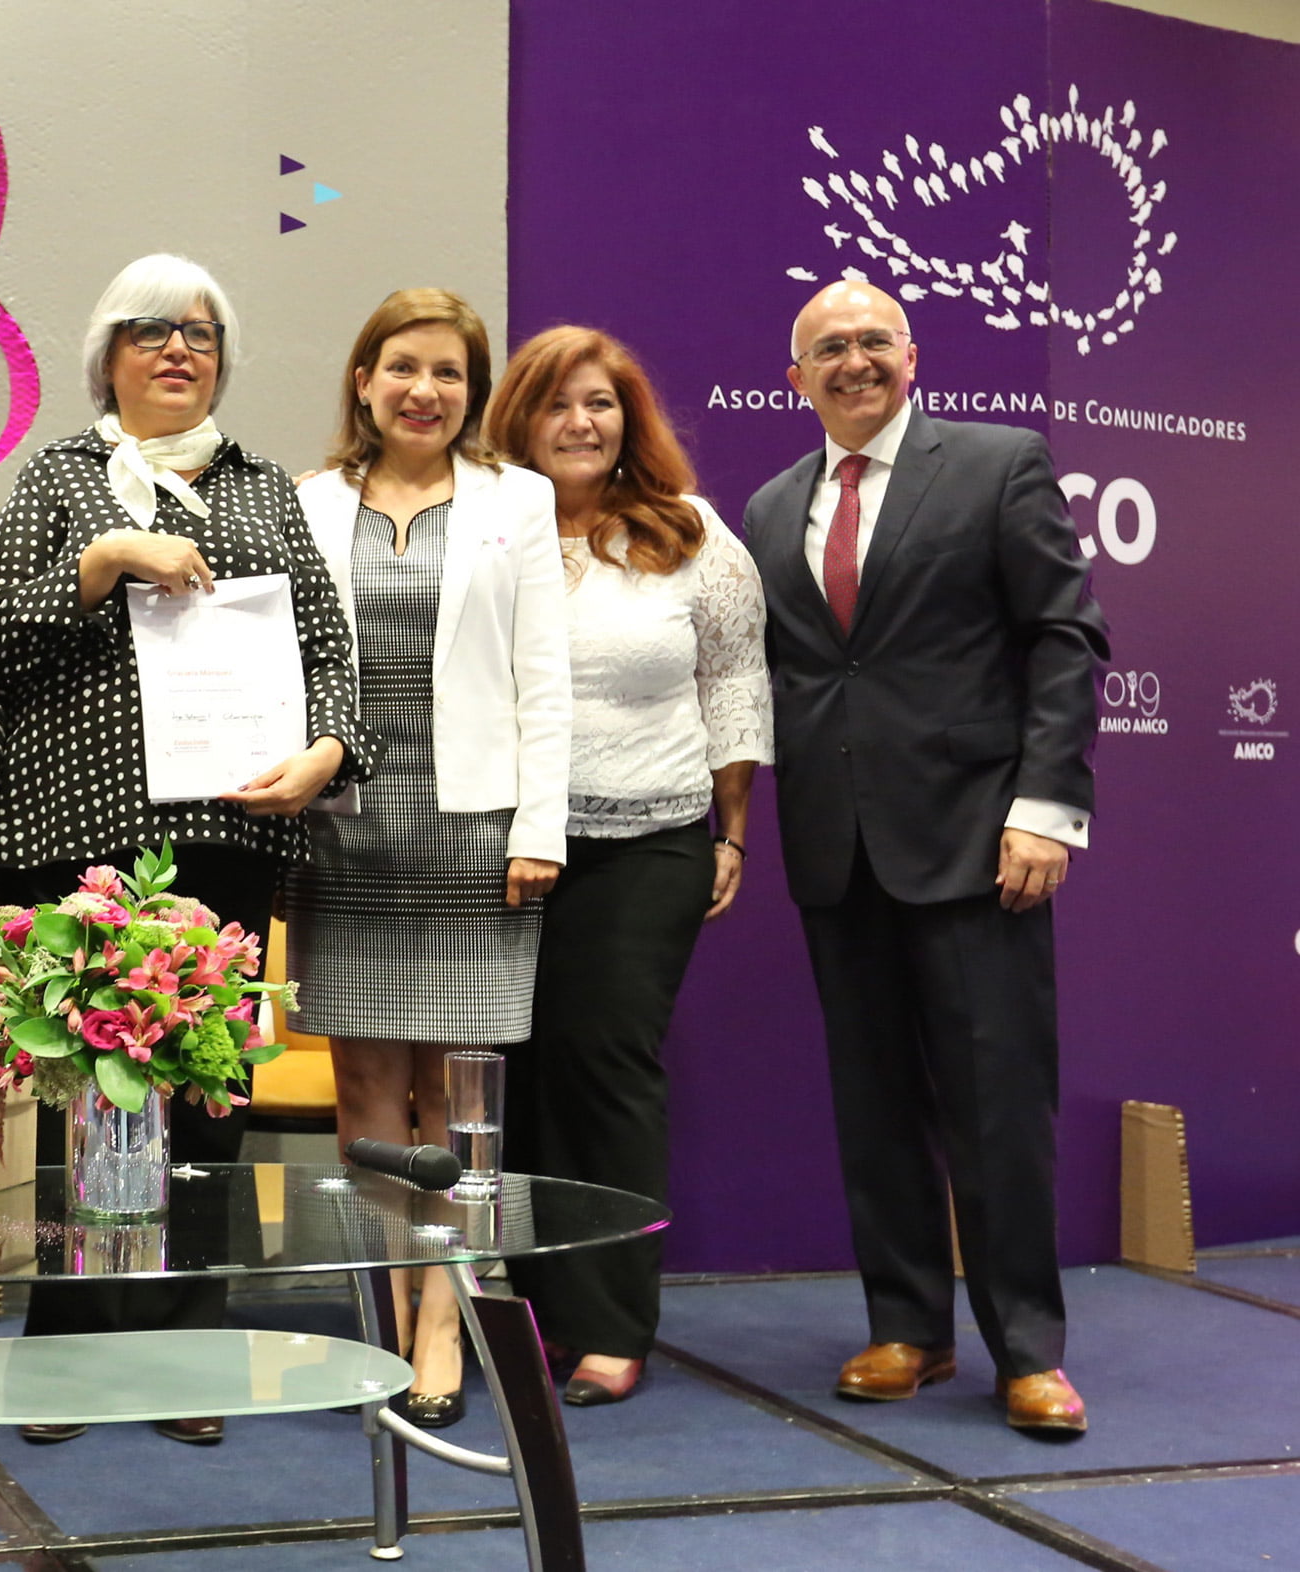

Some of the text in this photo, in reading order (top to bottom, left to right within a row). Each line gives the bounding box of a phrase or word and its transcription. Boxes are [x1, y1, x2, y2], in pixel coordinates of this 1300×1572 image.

[1054, 400, 1078, 422] DE
[1085, 399, 1246, 441] COMUNICADORES
[1099, 716, 1168, 734] EMIO AMCO
[1234, 742, 1275, 760] AMCO
